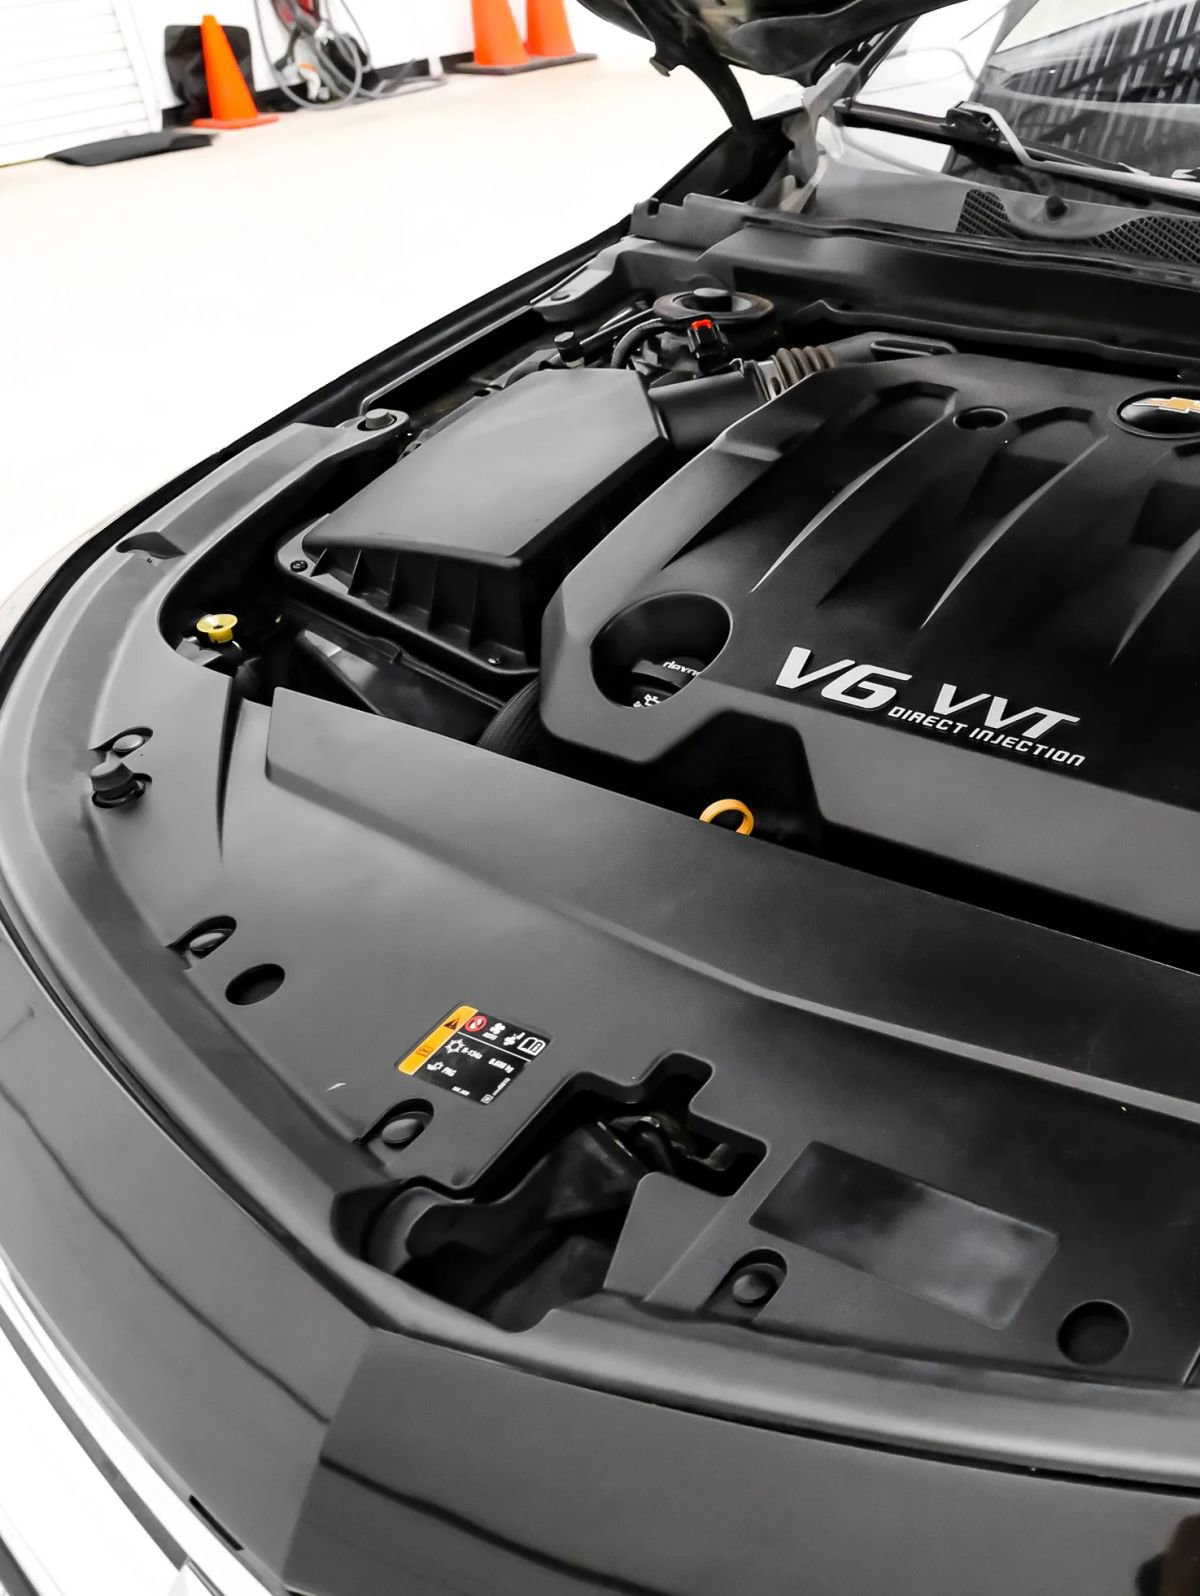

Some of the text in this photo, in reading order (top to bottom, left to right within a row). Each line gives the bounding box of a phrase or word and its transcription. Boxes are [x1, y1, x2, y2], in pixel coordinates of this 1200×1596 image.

[775, 645, 1081, 739] V6 VVT
[887, 705, 1086, 767] DIRECT INJECTION
